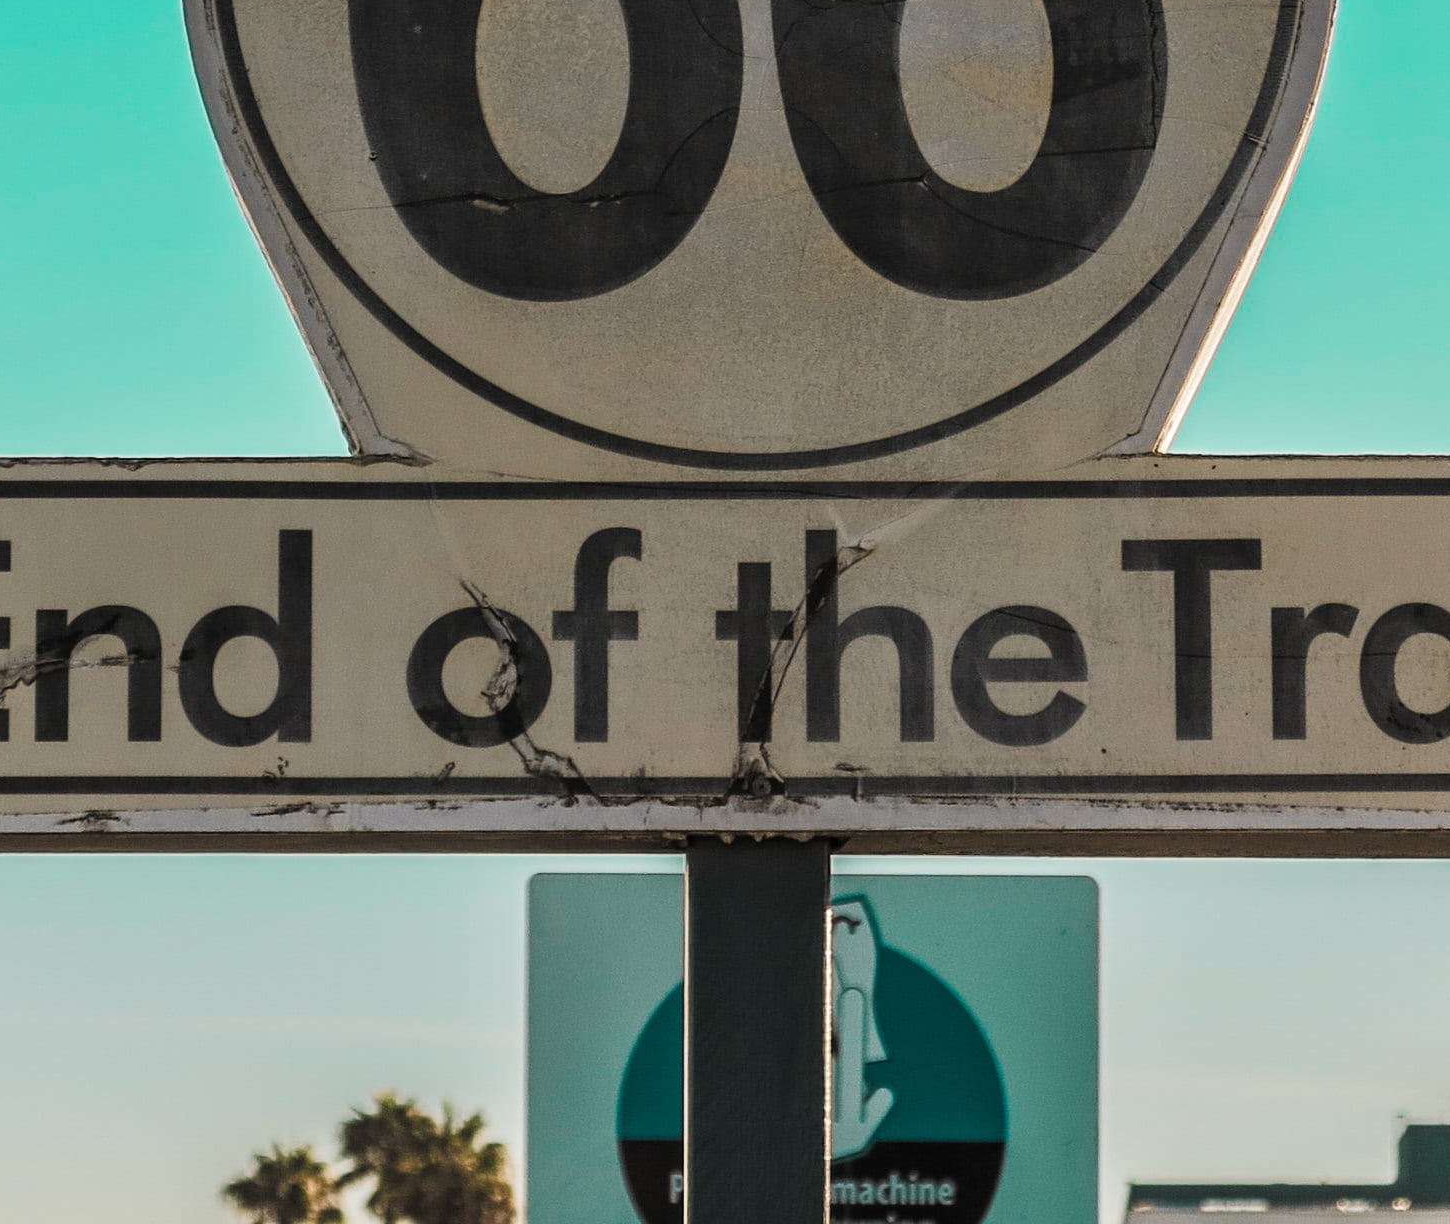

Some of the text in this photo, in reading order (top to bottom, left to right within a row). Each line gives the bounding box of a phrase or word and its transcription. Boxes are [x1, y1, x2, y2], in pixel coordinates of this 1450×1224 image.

[405, 526, 643, 748] of
[715, 528, 1088, 747] the
[830, 1172, 956, 1205] machine
